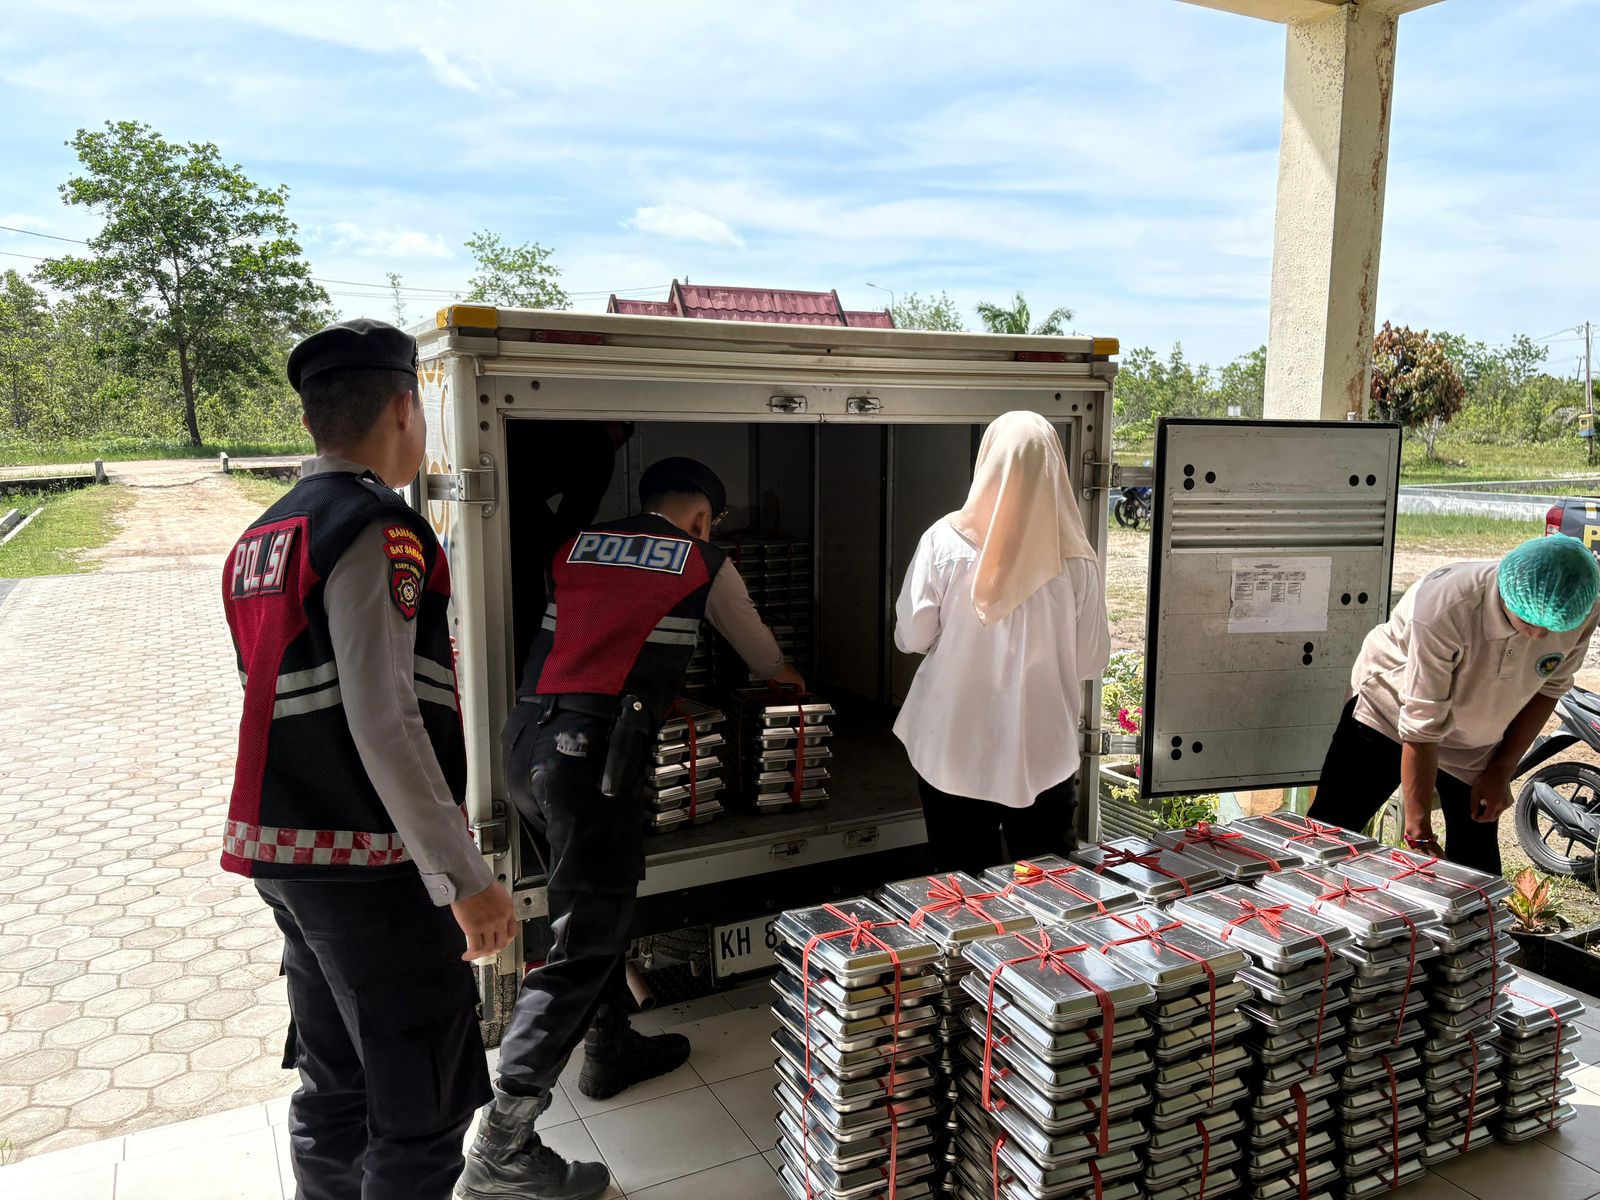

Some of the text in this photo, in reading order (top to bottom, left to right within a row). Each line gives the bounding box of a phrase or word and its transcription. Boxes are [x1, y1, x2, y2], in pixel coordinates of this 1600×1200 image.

[231, 533, 292, 594] POLISI
[572, 535, 687, 569] POLISI
[720, 921, 778, 960] KH 8
